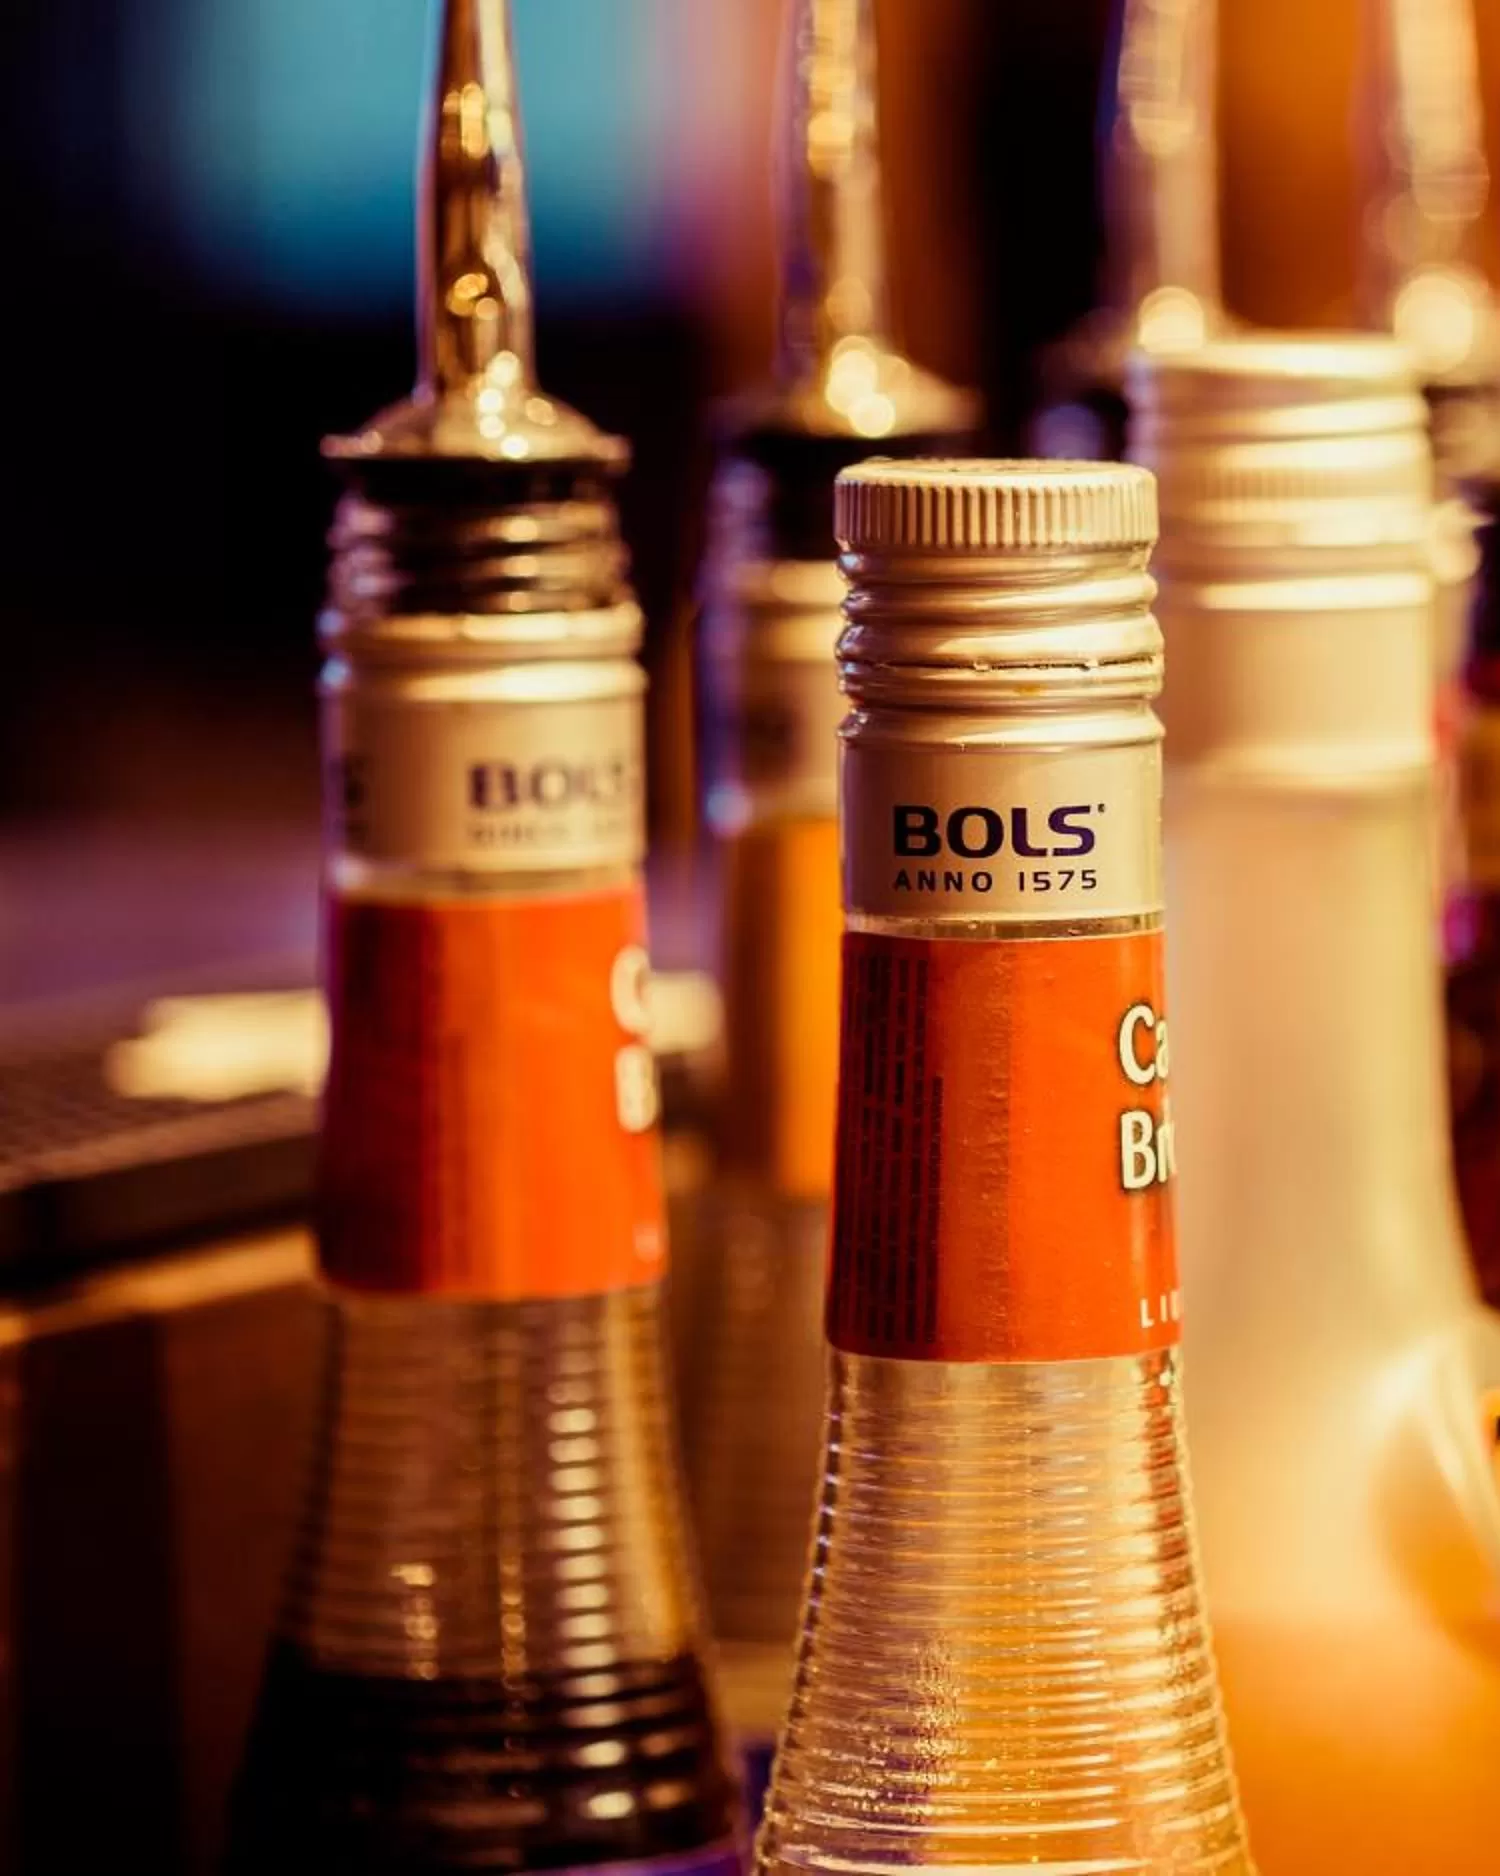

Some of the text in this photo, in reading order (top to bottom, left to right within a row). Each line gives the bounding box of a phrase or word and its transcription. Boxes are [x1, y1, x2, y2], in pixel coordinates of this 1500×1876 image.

[892, 804, 1096, 858] BOLS
[893, 869, 1098, 892] ANNO 1575
